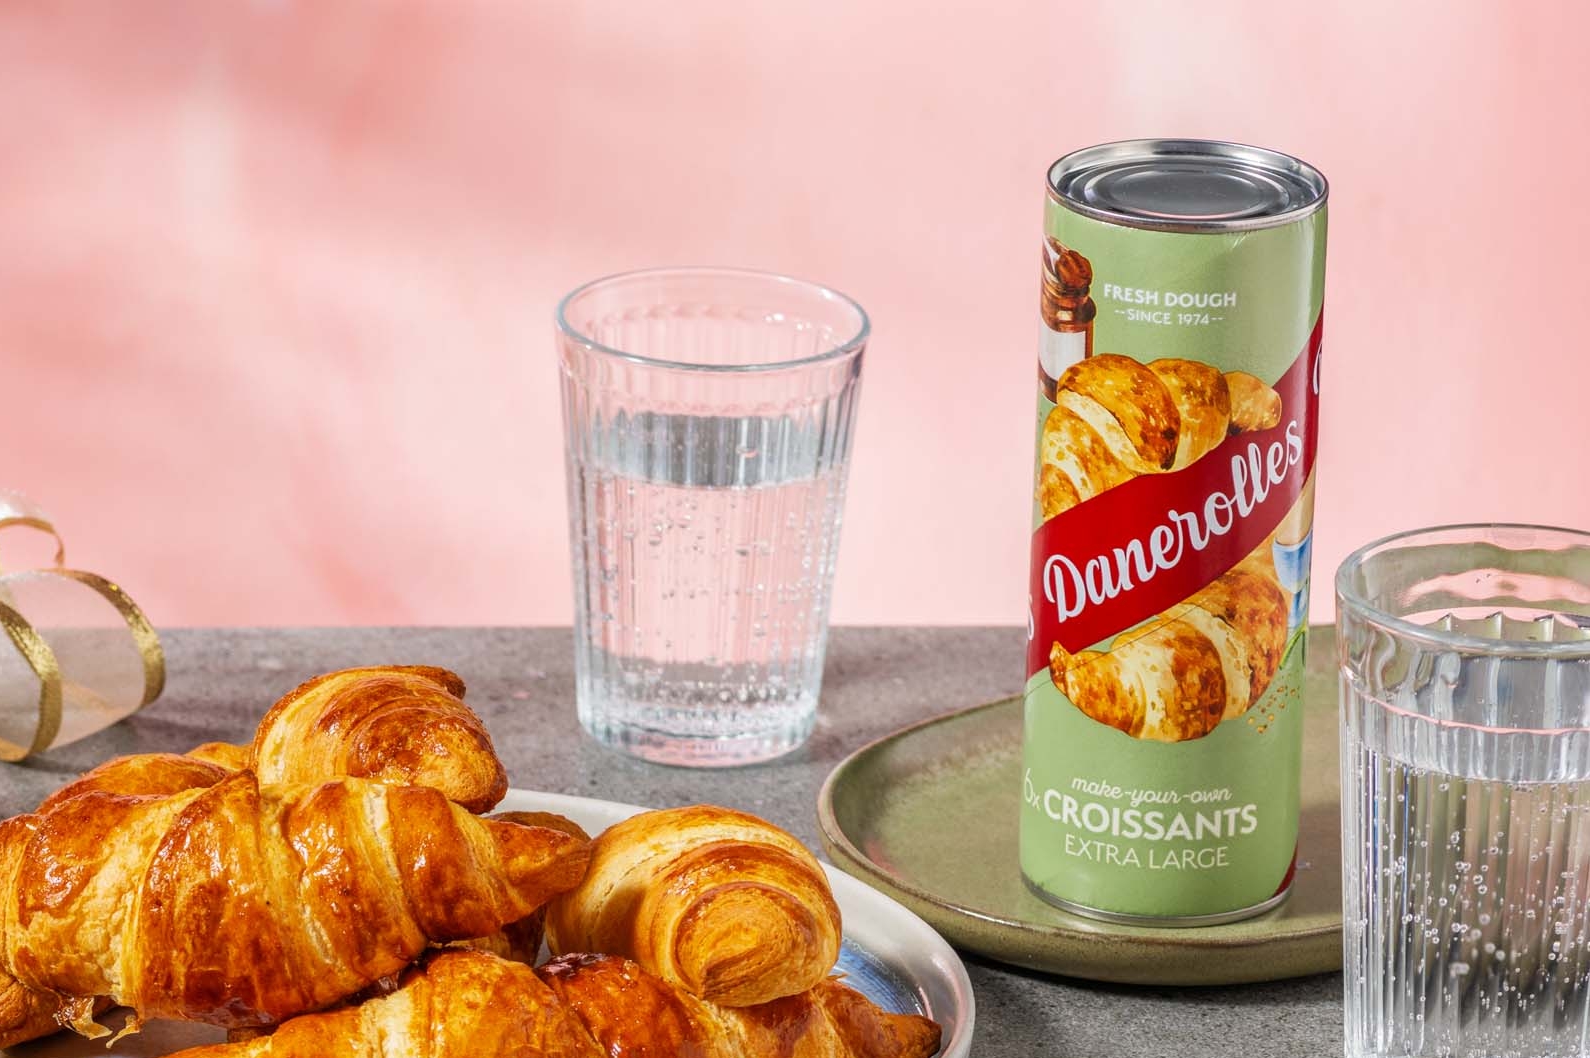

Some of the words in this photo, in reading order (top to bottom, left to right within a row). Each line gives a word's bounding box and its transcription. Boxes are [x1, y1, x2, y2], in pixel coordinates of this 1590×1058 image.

[1103, 283, 1159, 305] FRESH
[1164, 292, 1237, 308] DOUGH
[1042, 419, 1304, 625] Danerolles
[1070, 776, 1232, 807] make-your-own
[1043, 788, 1259, 842] CROISSANTS
[1065, 832, 1141, 868] EXTRA
[1148, 846, 1230, 870] LARGE
